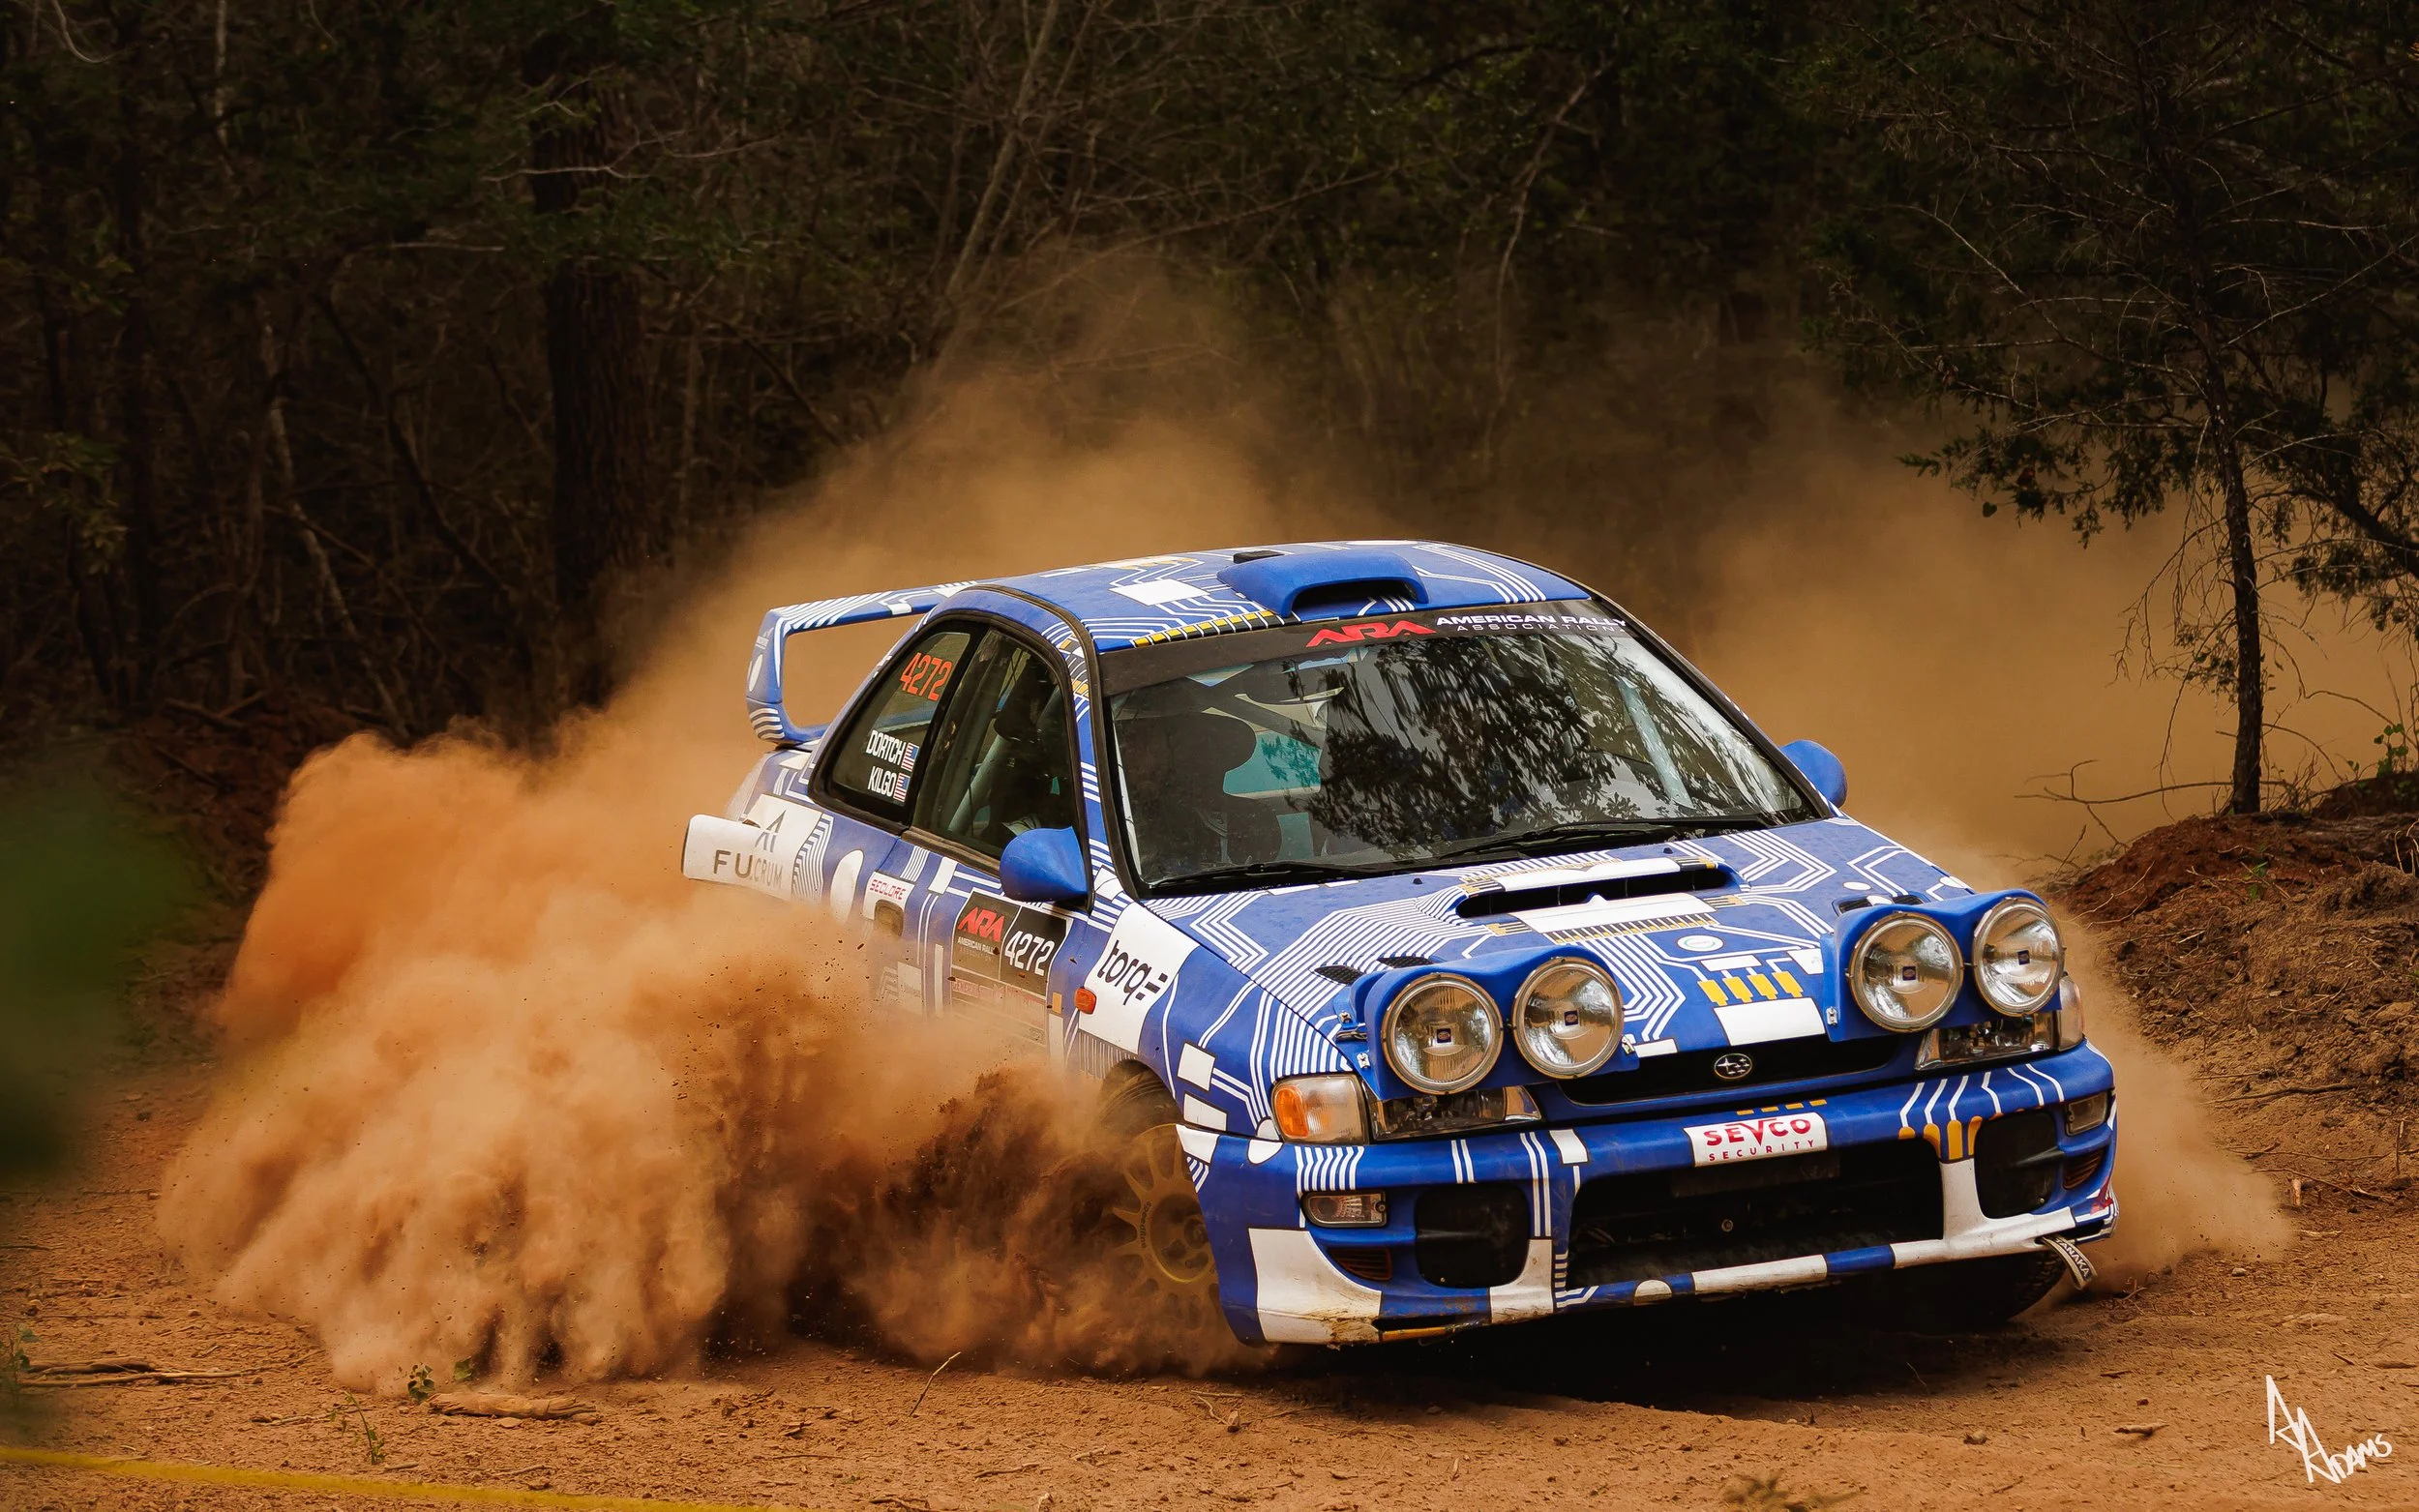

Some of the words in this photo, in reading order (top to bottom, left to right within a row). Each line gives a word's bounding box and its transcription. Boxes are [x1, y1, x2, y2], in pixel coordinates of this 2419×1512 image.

[1305, 620, 1437, 648] ARA
[1436, 614, 1557, 626] AMERICAN
[1561, 615, 1627, 627] RALLY
[1456, 623, 1615, 633] ASSOCIATION
[900, 652, 952, 701] 4272
[865, 729, 907, 766] DORTCH
[867, 765, 897, 797] KILGO
[713, 849, 784, 889] FUCRUM
[869, 878, 907, 901] SECLORE
[957, 906, 1005, 943] ARA
[958, 935, 983, 951] AMERICAN
[1004, 931, 1056, 976] 4272
[1703, 1117, 1811, 1147] SEVCO
[1708, 1140, 1814, 1162] SECURITY
[2054, 1238, 2091, 1278] TANAKA
